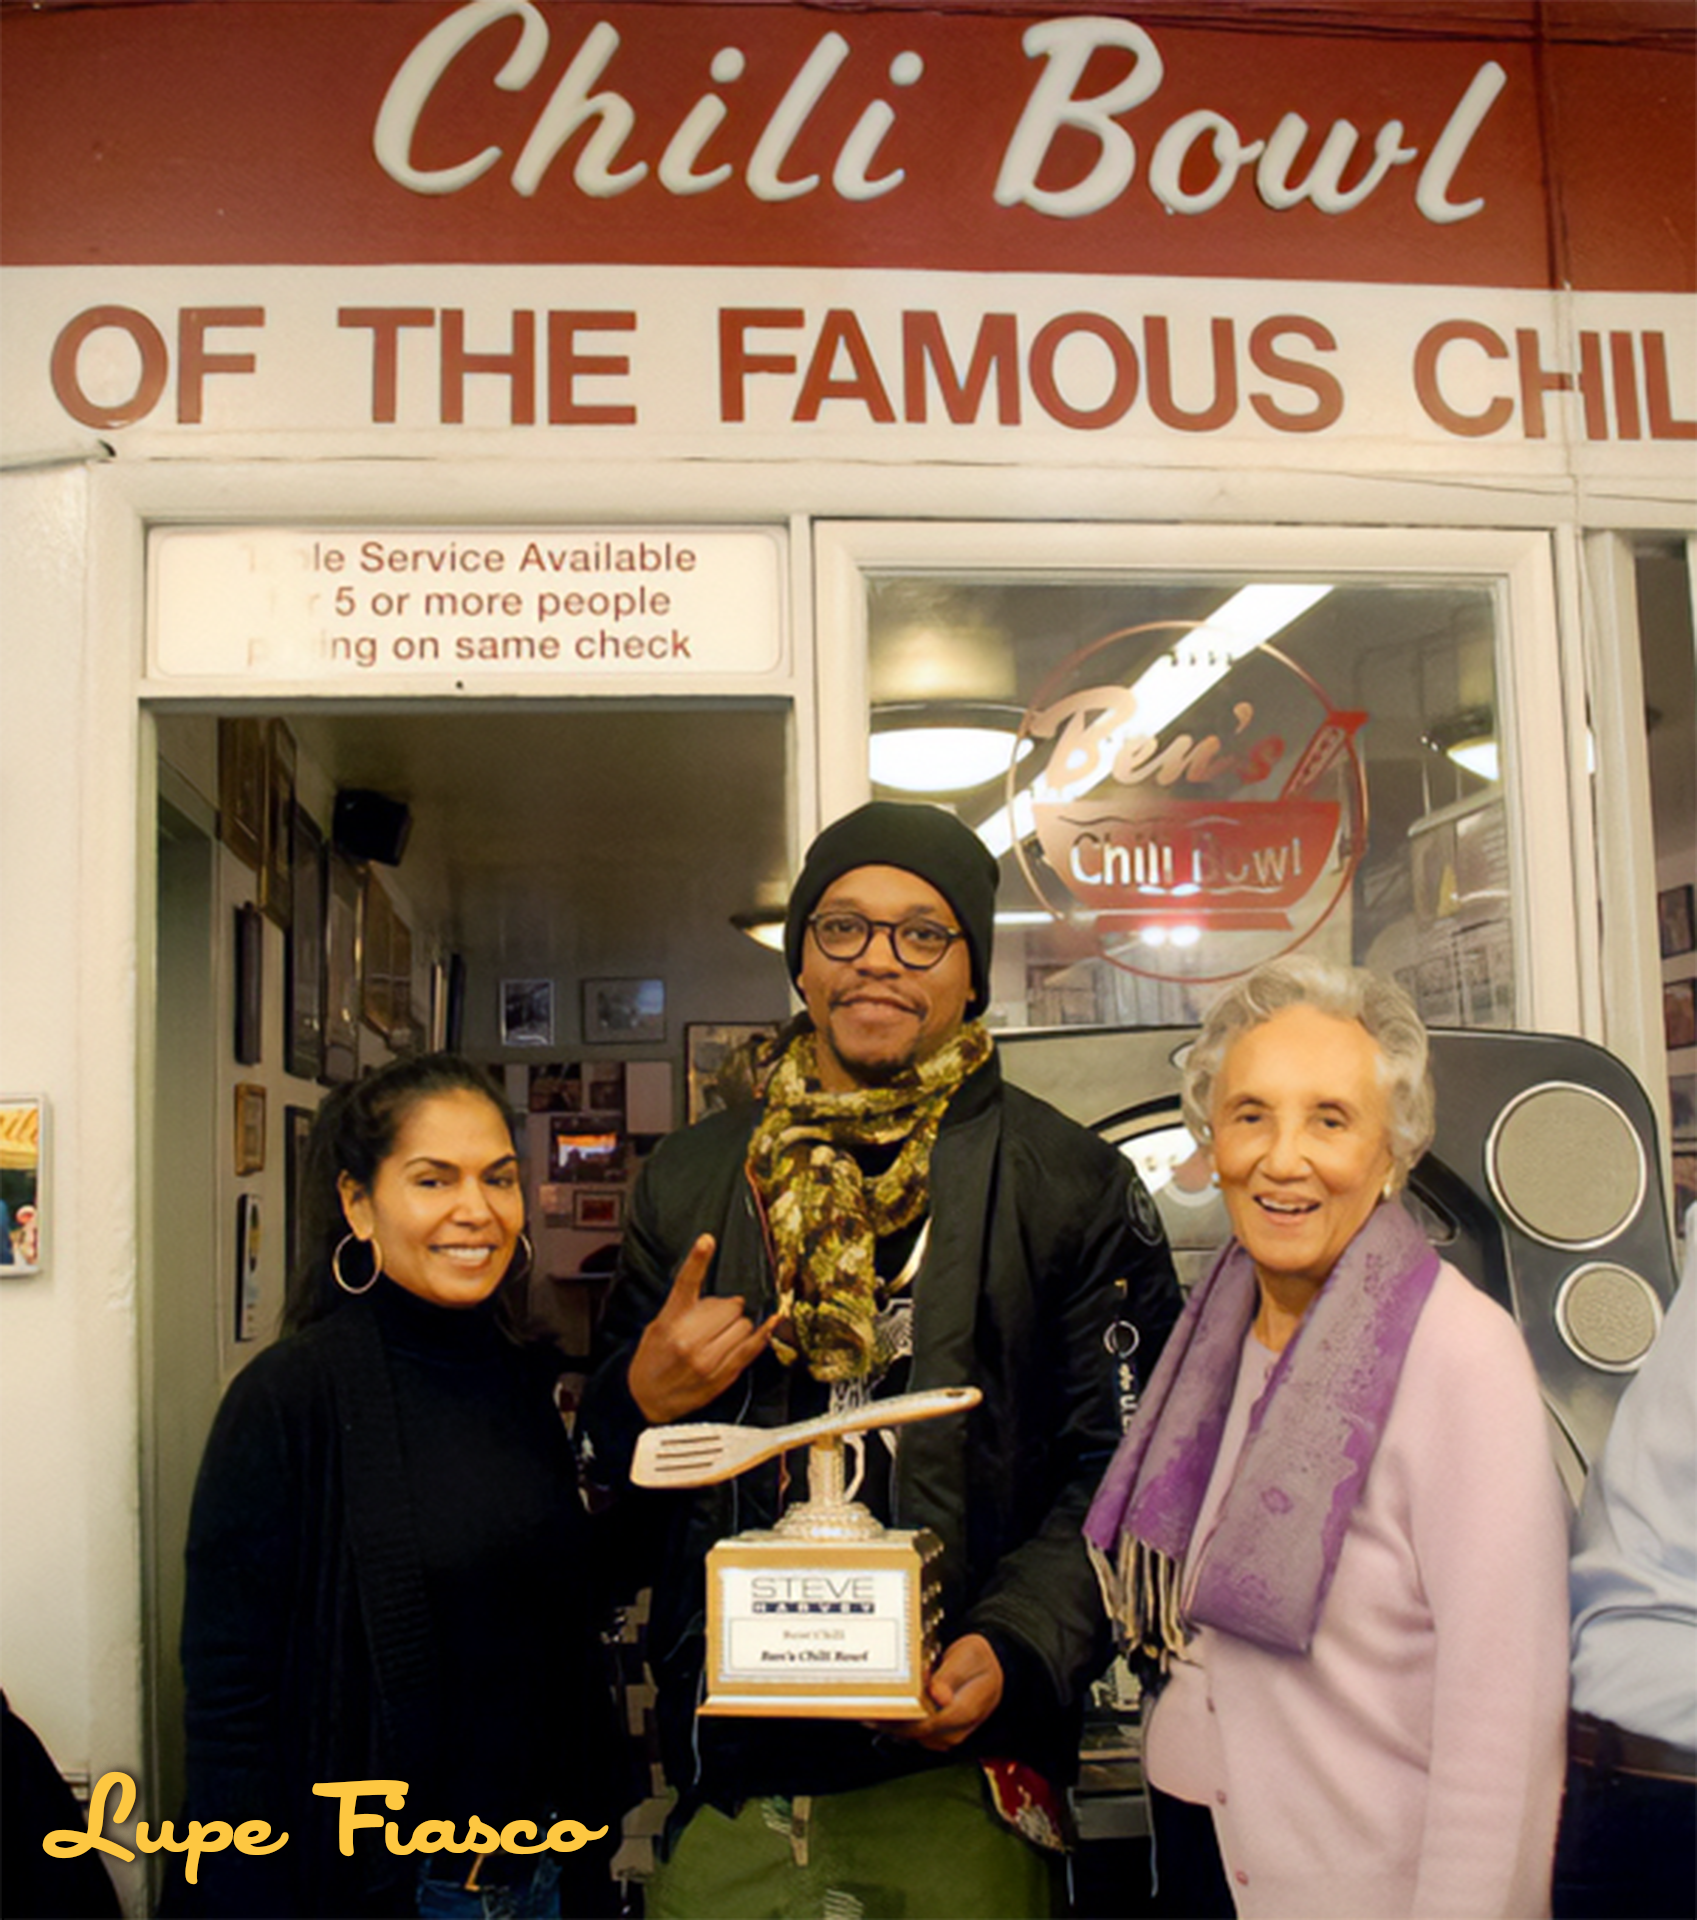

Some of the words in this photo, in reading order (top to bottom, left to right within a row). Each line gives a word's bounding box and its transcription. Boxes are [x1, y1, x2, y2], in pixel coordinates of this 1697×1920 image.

[373, 0, 923, 200] Chili
[994, 16, 1506, 223] Bowl
[50, 305, 265, 429] OF
[337, 307, 638, 425] THE
[718, 308, 1344, 433] FAMOUS
[1413, 319, 1697, 441] CHIL
[359, 541, 505, 574] Service
[519, 541, 697, 573] Available
[335, 586, 355, 616] 5
[371, 593, 410, 616] or
[424, 593, 523, 616] more
[537, 585, 671, 622] people
[393, 637, 439, 660] on
[455, 637, 560, 660] same
[574, 628, 692, 660] check
[751, 1577, 875, 1599] STEVE
